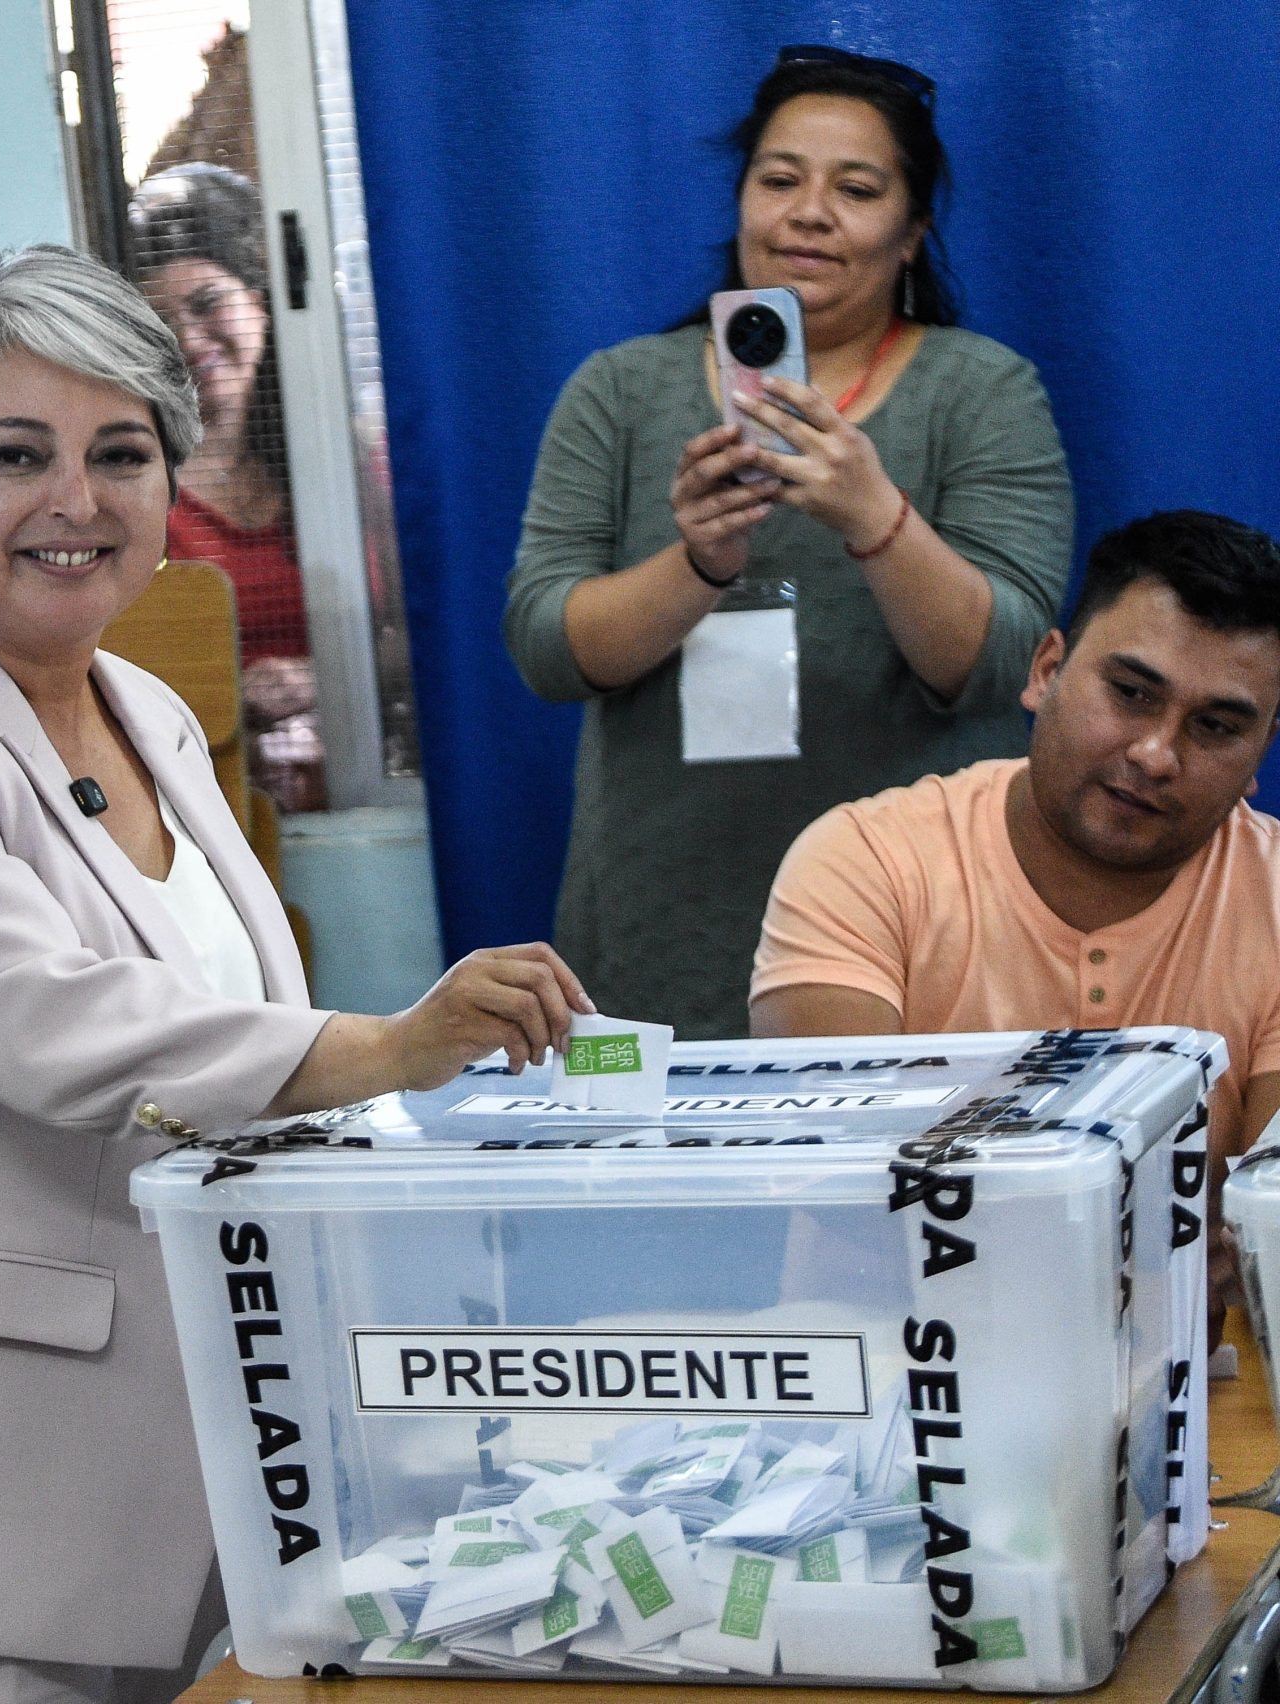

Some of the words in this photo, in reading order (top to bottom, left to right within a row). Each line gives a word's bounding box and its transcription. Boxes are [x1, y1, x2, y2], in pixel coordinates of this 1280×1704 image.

[599, 1043, 617, 1069] VEL
[618, 1041, 635, 1068] SER
[667, 1056, 950, 1075] ELLADA
[502, 1093, 902, 1112] PRIDENTE
[400, 1347, 815, 1401] PRESIDENTE
[220, 1220, 321, 1567] SELLADA
[903, 1315, 979, 1669] SELLADA
